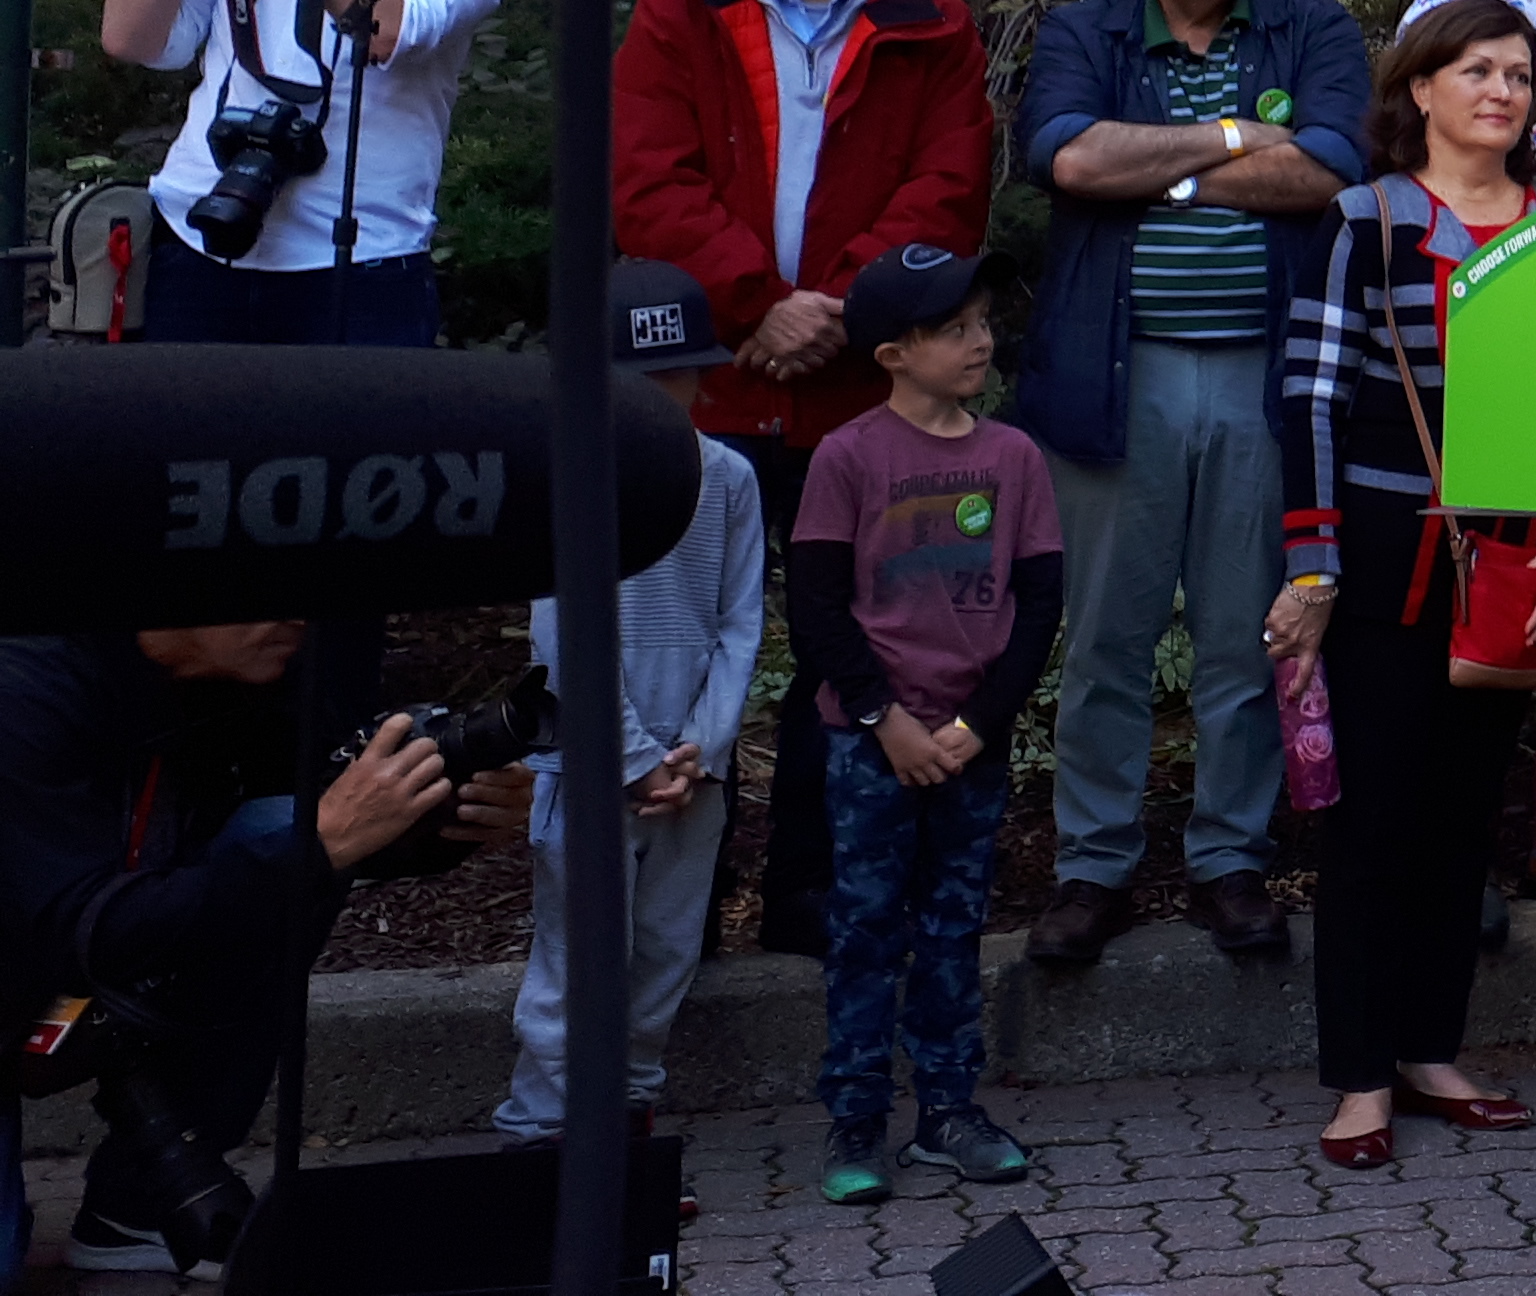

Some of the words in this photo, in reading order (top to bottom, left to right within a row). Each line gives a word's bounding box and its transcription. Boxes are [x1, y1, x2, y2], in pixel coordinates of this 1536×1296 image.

[1467, 244, 1507, 285] CHOOSE
[165, 451, 506, 549] RØDE
[951, 571, 996, 605] 76
